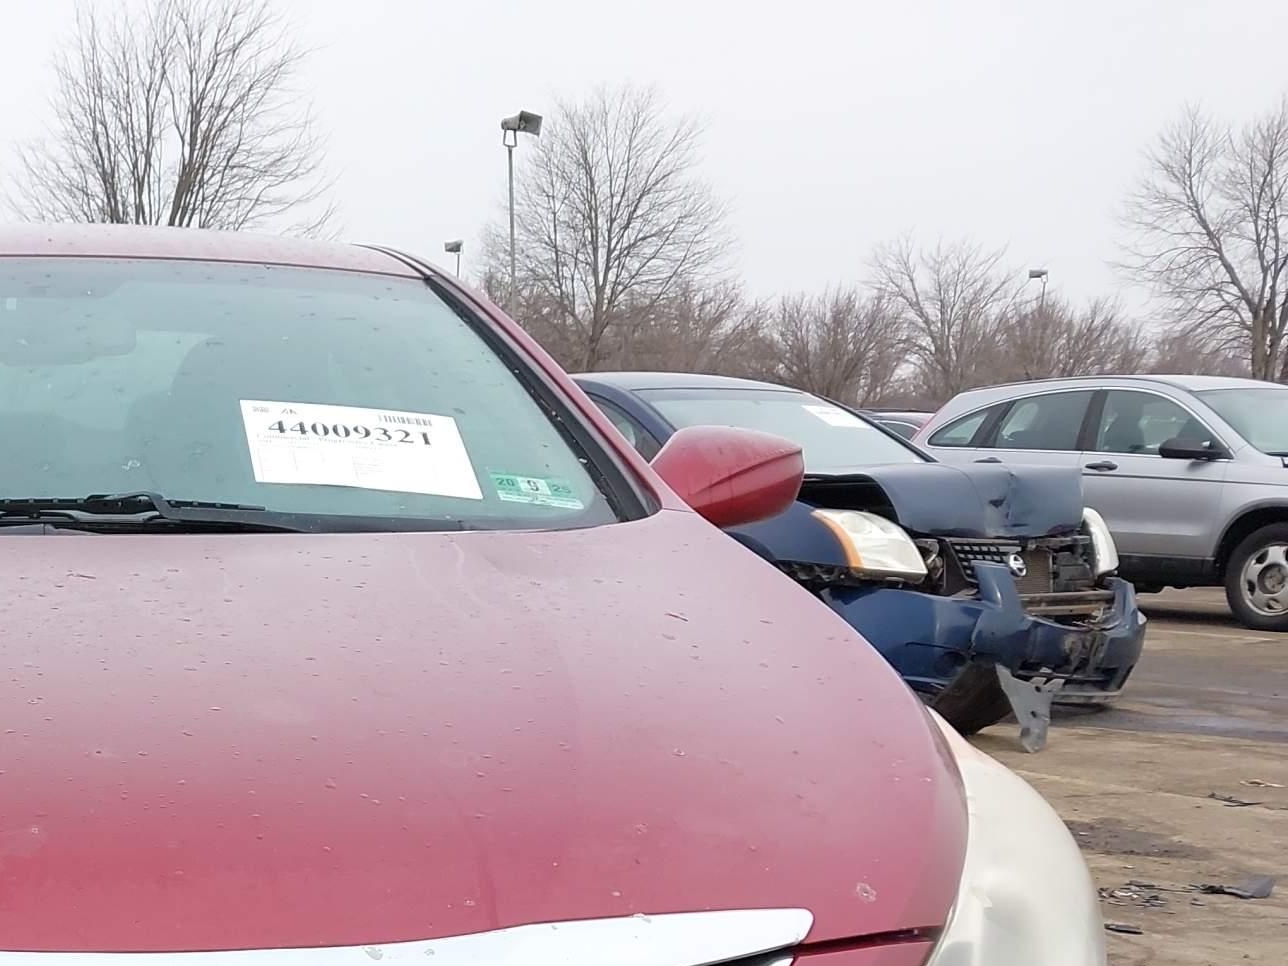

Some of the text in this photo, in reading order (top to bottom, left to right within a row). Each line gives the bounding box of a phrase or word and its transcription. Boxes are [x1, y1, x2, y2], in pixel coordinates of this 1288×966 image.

[267, 419, 432, 446] 44009321
[495, 477, 516, 487] 20
[526, 479, 540, 492] 9
